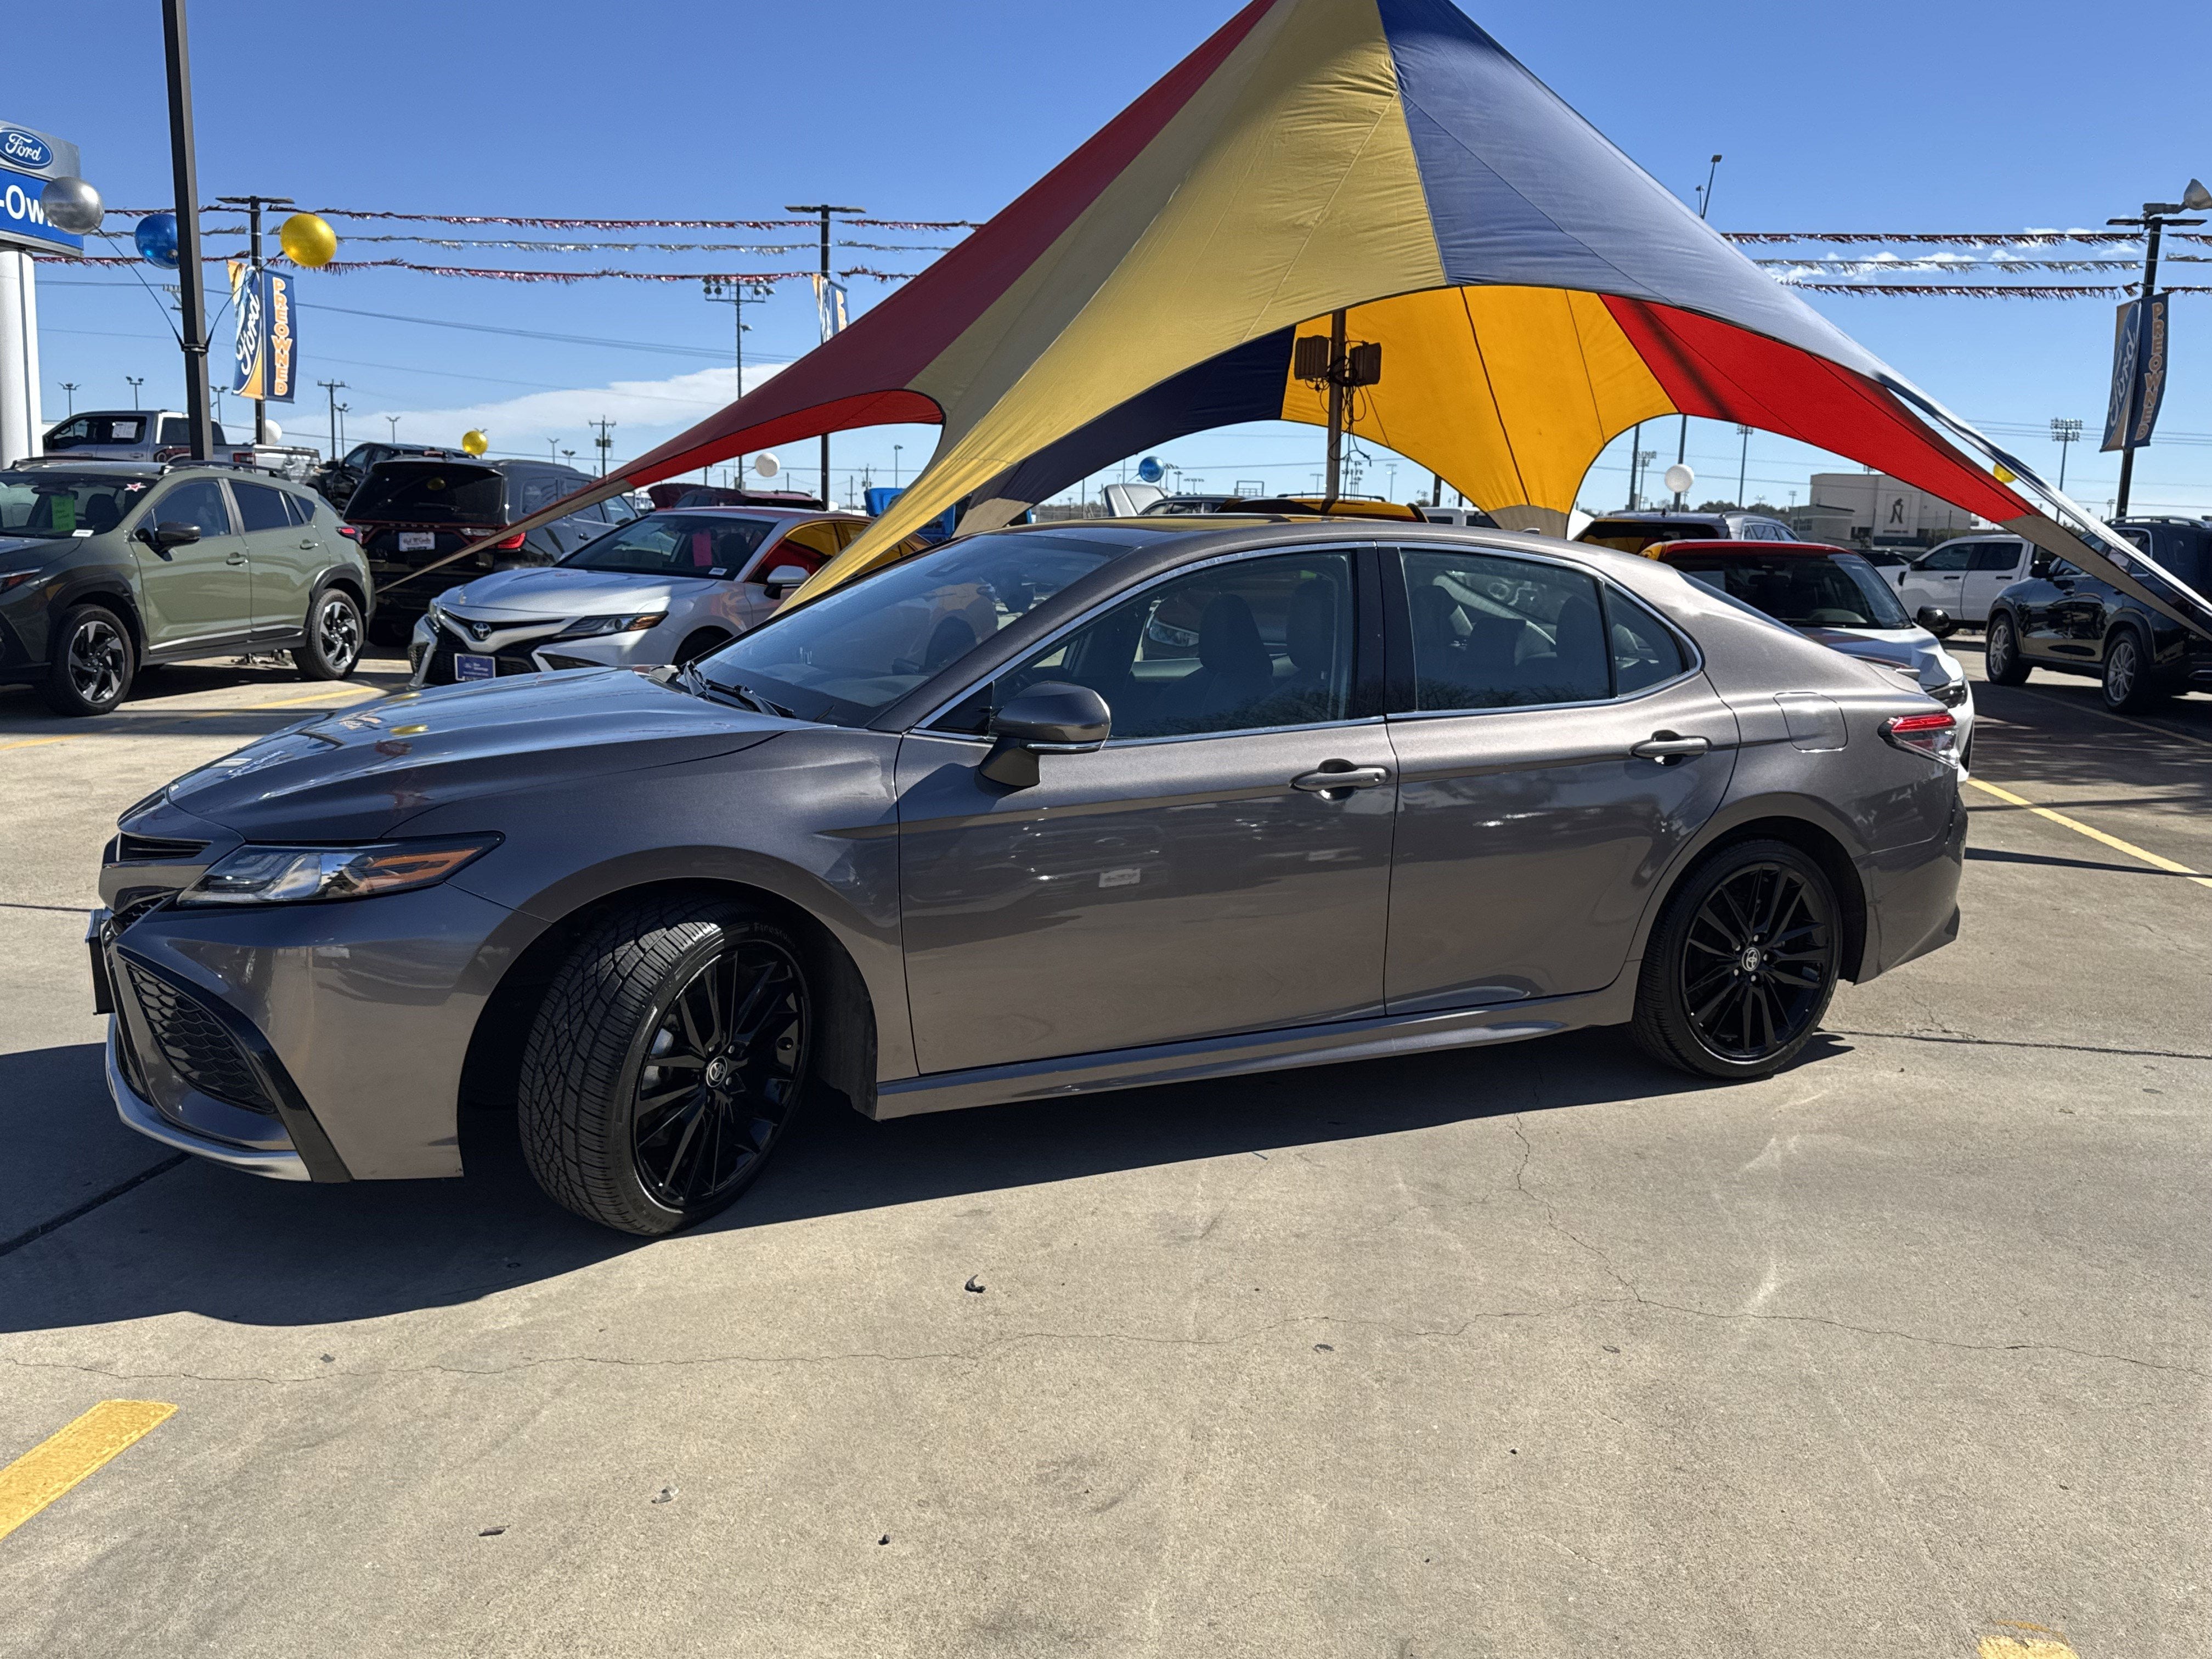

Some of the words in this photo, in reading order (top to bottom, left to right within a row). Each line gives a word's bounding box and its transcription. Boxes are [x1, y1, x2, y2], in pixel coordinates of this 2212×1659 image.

[5, 133, 42, 161] Ford
[235, 289, 261, 376] Ford
[270, 276, 293, 396] PREOWNED
[2109, 326, 2136, 427] Ford
[2134, 302, 2165, 441] PREOWNED
